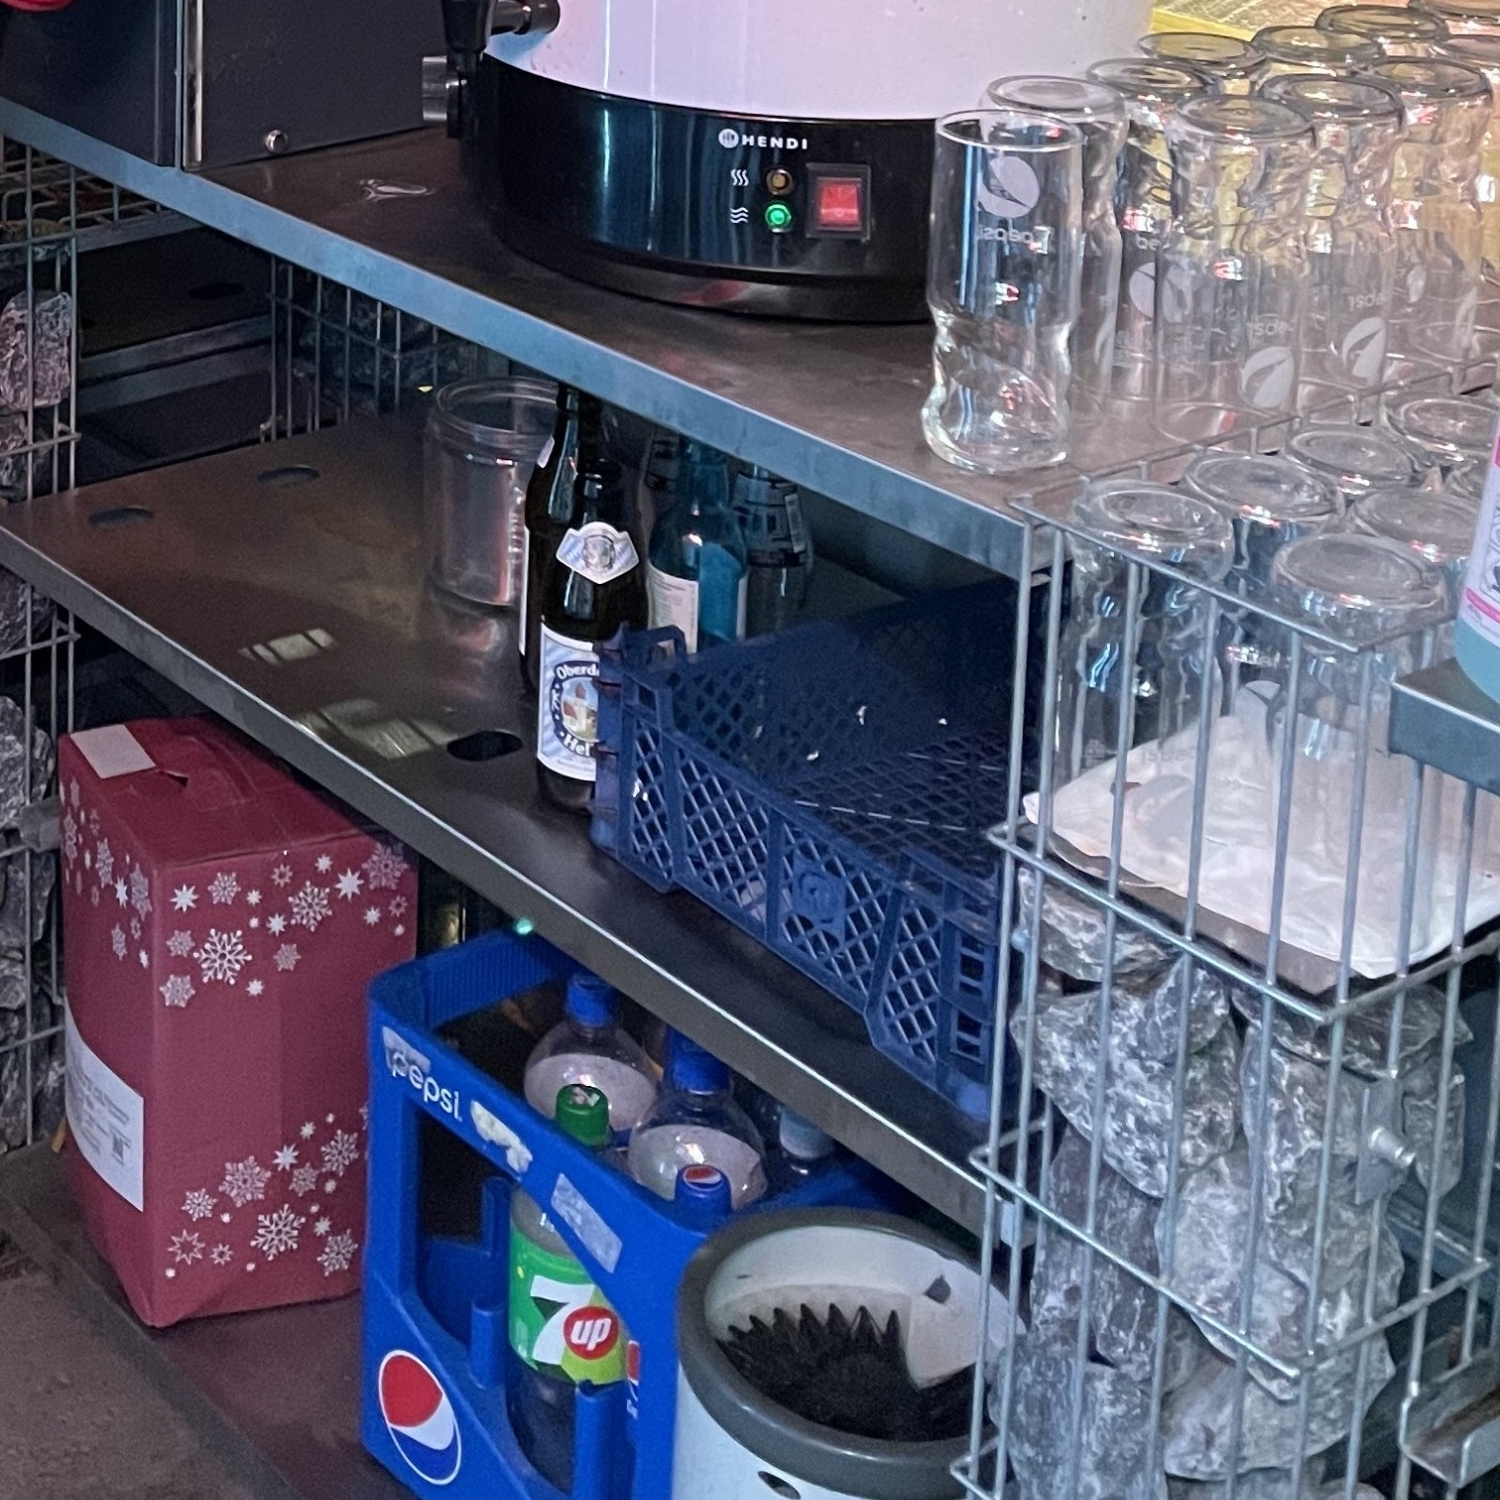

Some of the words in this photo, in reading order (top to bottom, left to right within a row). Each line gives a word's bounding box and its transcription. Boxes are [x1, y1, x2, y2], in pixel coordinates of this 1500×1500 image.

[741, 134, 808, 150] HENDI
[563, 733, 595, 758] Hel
[392, 1051, 461, 1121] pepsi
